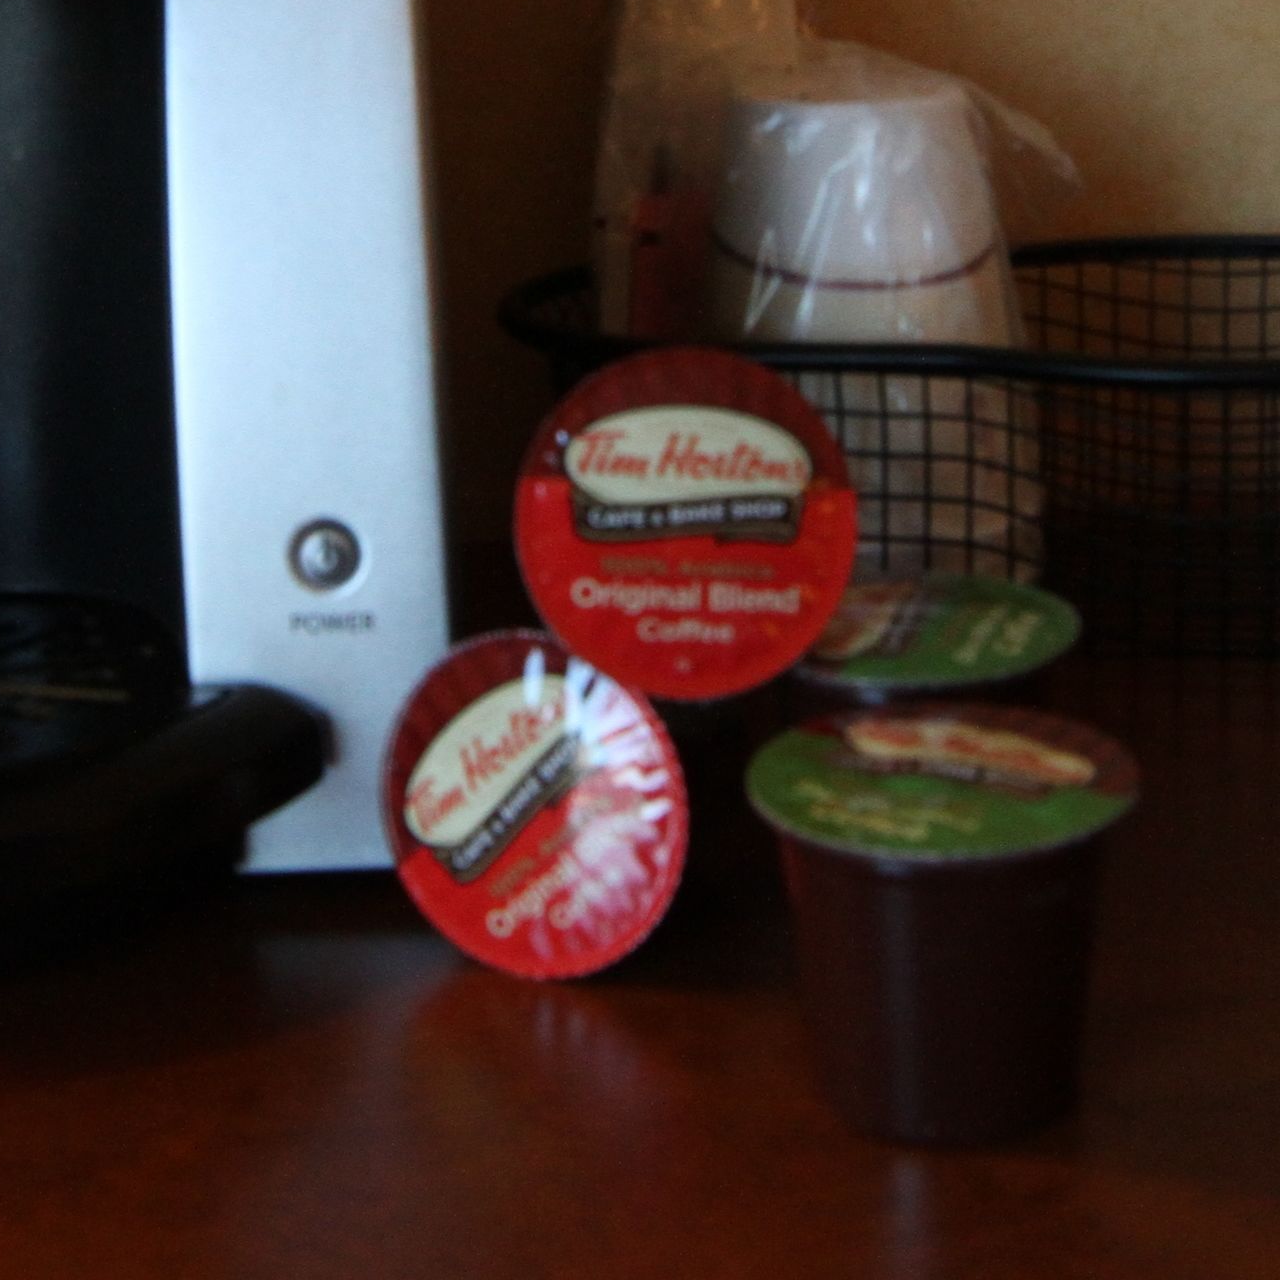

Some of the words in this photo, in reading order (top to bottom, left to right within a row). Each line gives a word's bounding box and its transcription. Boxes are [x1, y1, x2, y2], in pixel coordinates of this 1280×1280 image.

[572, 428, 650, 478] Tim
[570, 577, 703, 616] Original
[707, 581, 801, 613] Blend
[288, 610, 377, 635] POWER
[635, 616, 737, 645] Coffee
